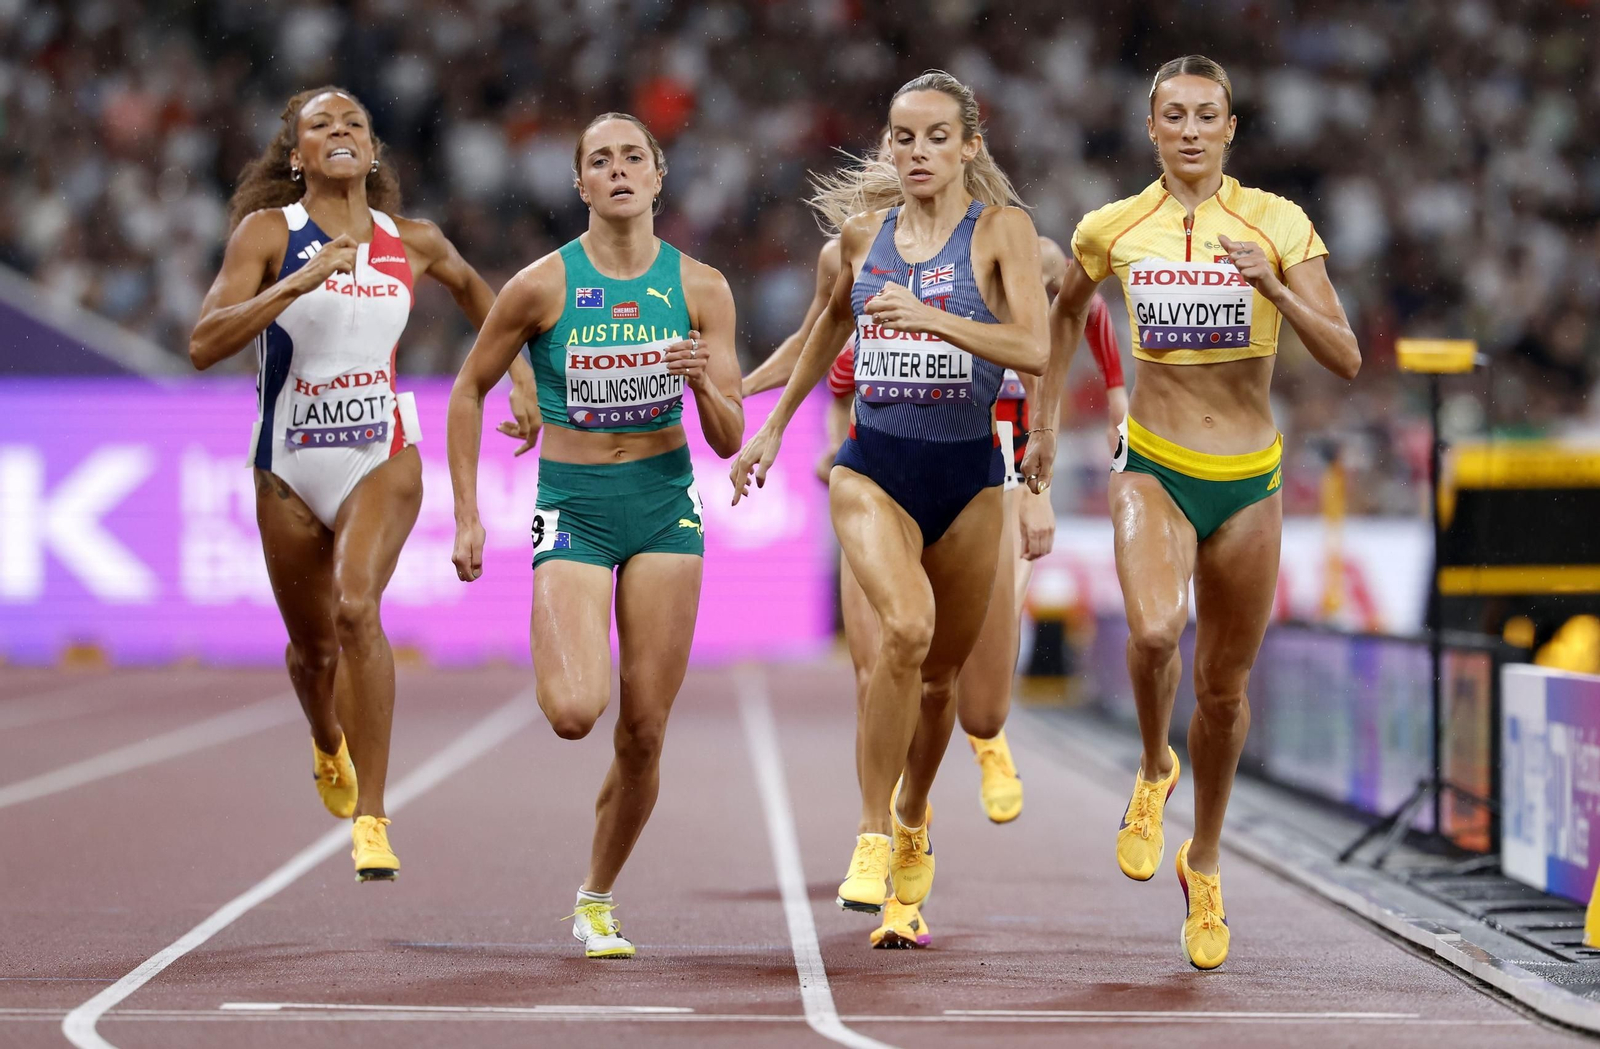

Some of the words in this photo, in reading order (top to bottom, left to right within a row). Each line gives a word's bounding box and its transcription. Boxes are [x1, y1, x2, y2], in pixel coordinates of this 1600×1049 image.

[1131, 270, 1250, 286] HONDA
[325, 280, 398, 297] RANCE
[922, 284, 954, 297] Novuna
[1137, 298, 1246, 325] GALVYDYTĖ
[567, 323, 679, 346] AUSTRALIA
[1225, 331, 1245, 343] 25
[569, 350, 668, 370] HOND
[859, 352, 921, 378] HUNTER
[926, 353, 968, 379] BELL
[294, 369, 389, 397] HONDA
[570, 373, 681, 404] HOLLINGSWORTH
[946, 388, 967, 399] 25
